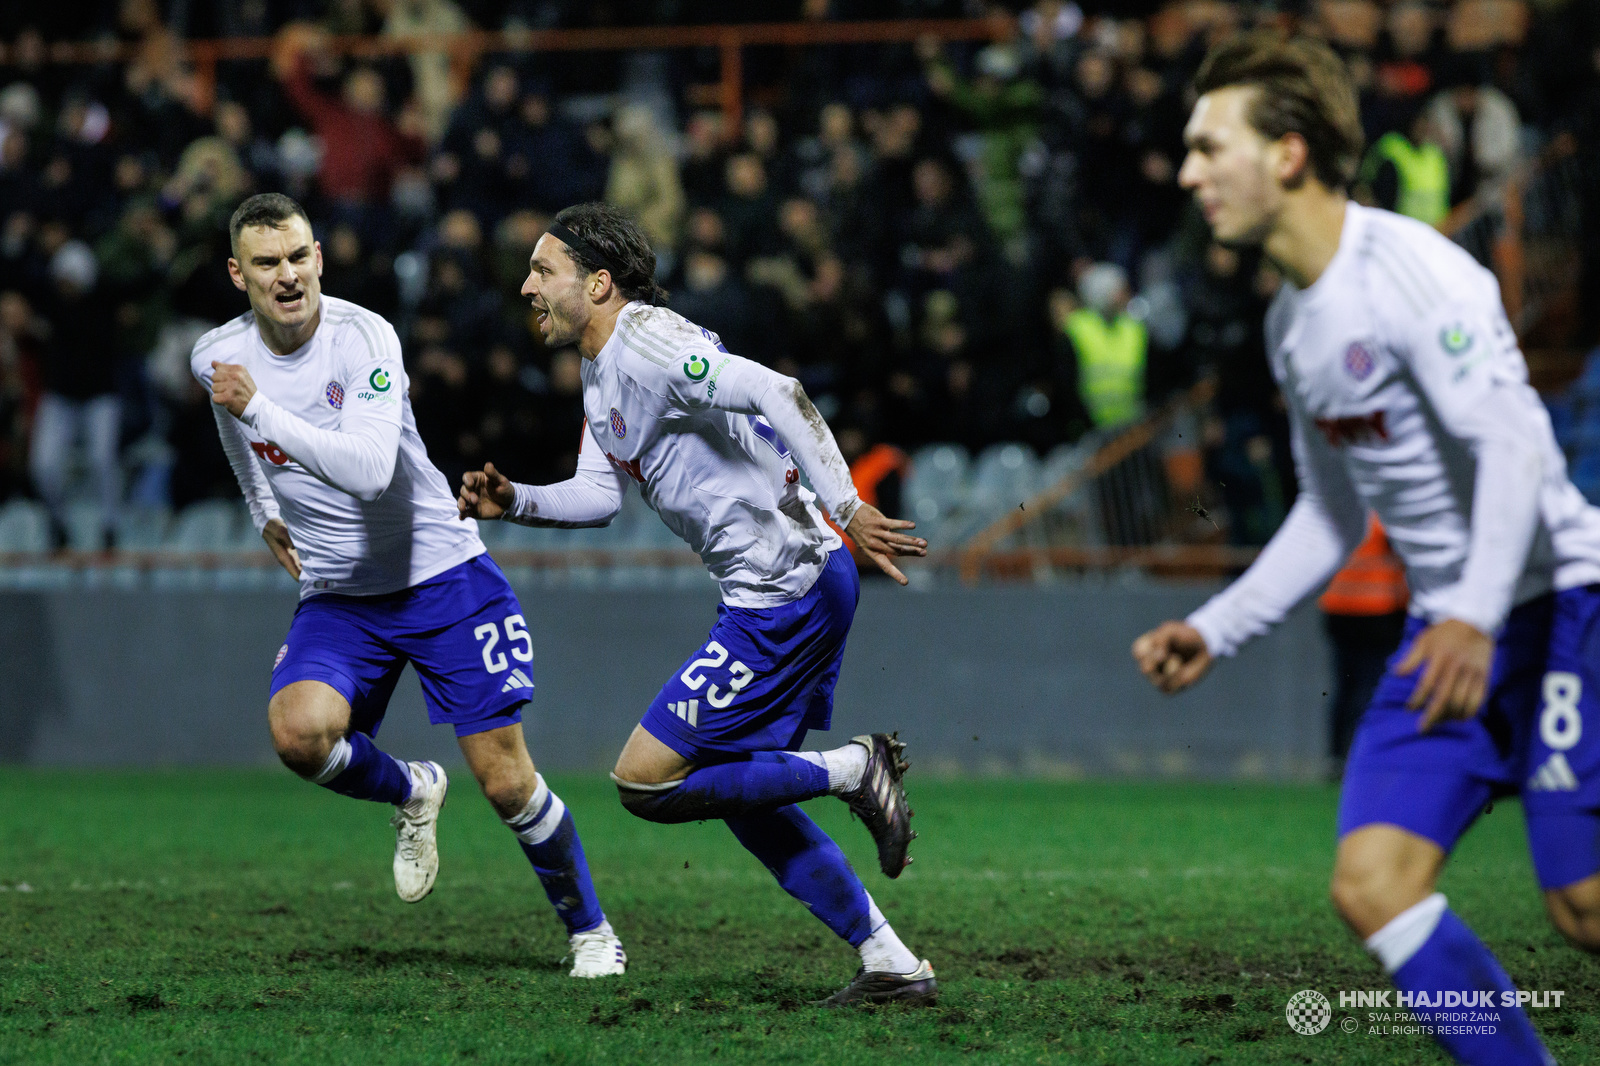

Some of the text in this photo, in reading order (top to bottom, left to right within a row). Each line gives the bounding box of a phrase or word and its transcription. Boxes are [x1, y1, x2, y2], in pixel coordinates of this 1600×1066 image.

[474, 614, 534, 674] 25
[680, 640, 754, 708] 23
[1540, 670, 1583, 751] 8
